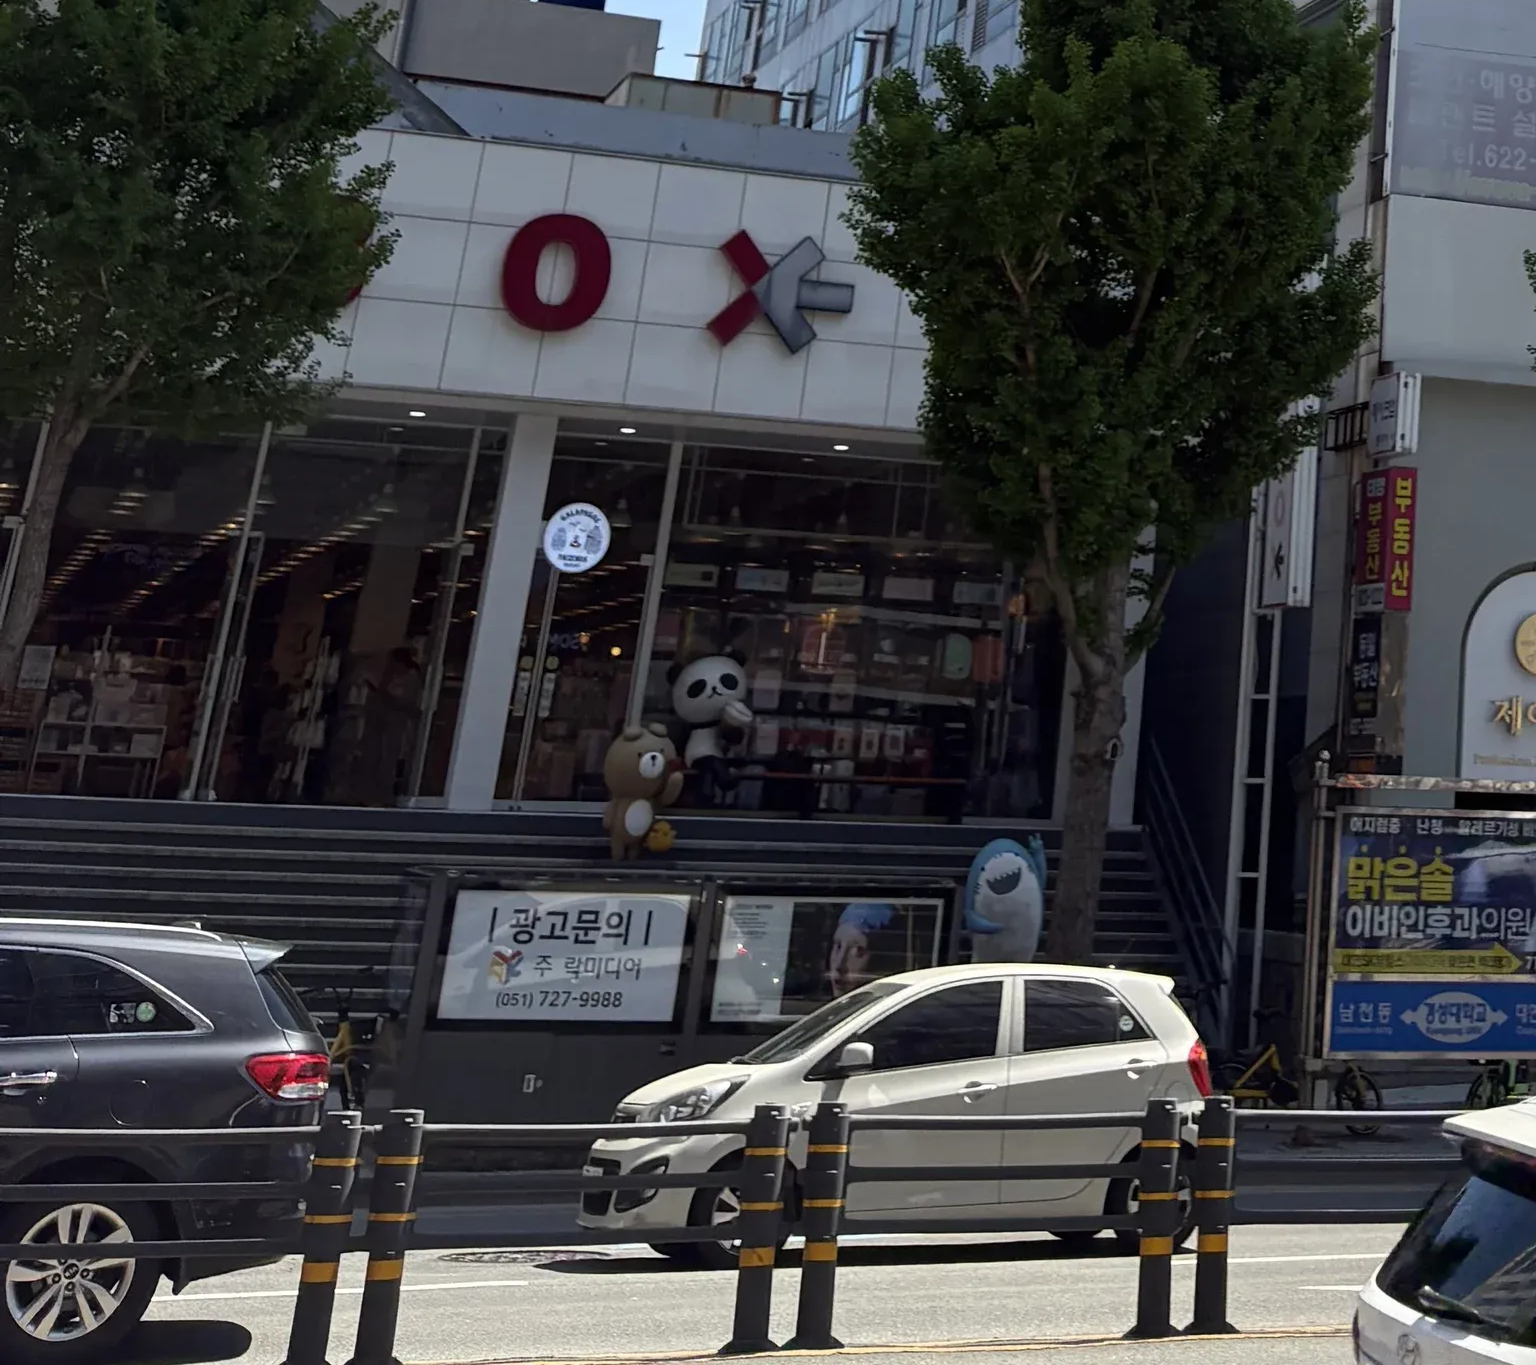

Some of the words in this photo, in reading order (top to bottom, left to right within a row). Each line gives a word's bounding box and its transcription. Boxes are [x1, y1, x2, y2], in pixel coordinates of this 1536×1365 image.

[1391, 477, 1413, 597] 부동산
[1350, 816, 1401, 835] 어지럼증
[1416, 817, 1443, 836] 난청
[509, 907, 633, 946] 광고문의
[1345, 904, 1531, 940] 이비인후과의원
[495, 991, 534, 1009] (051)
[539, 990, 623, 1008] 727-9988
[1425, 1001, 1488, 1024] 경성대학교
